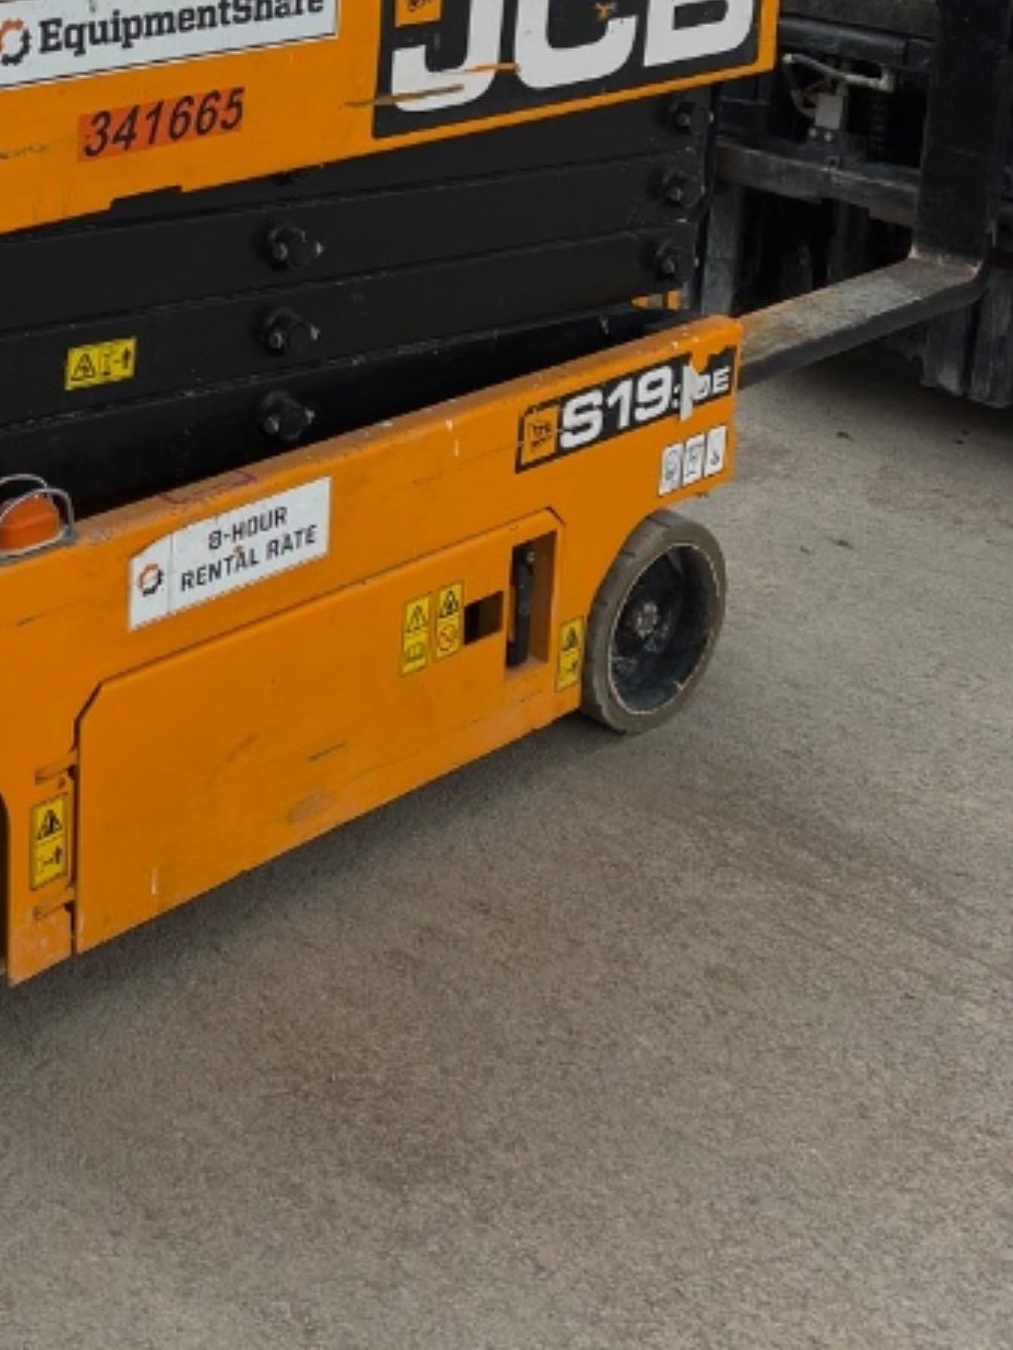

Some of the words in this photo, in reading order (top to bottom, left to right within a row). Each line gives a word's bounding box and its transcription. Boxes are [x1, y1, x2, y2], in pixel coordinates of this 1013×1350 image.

[84, 86, 245, 157] 341665
[181, 548, 259, 592] RENTAL
[266, 524, 317, 559] RATE
[208, 506, 288, 551] 8-HOUR
